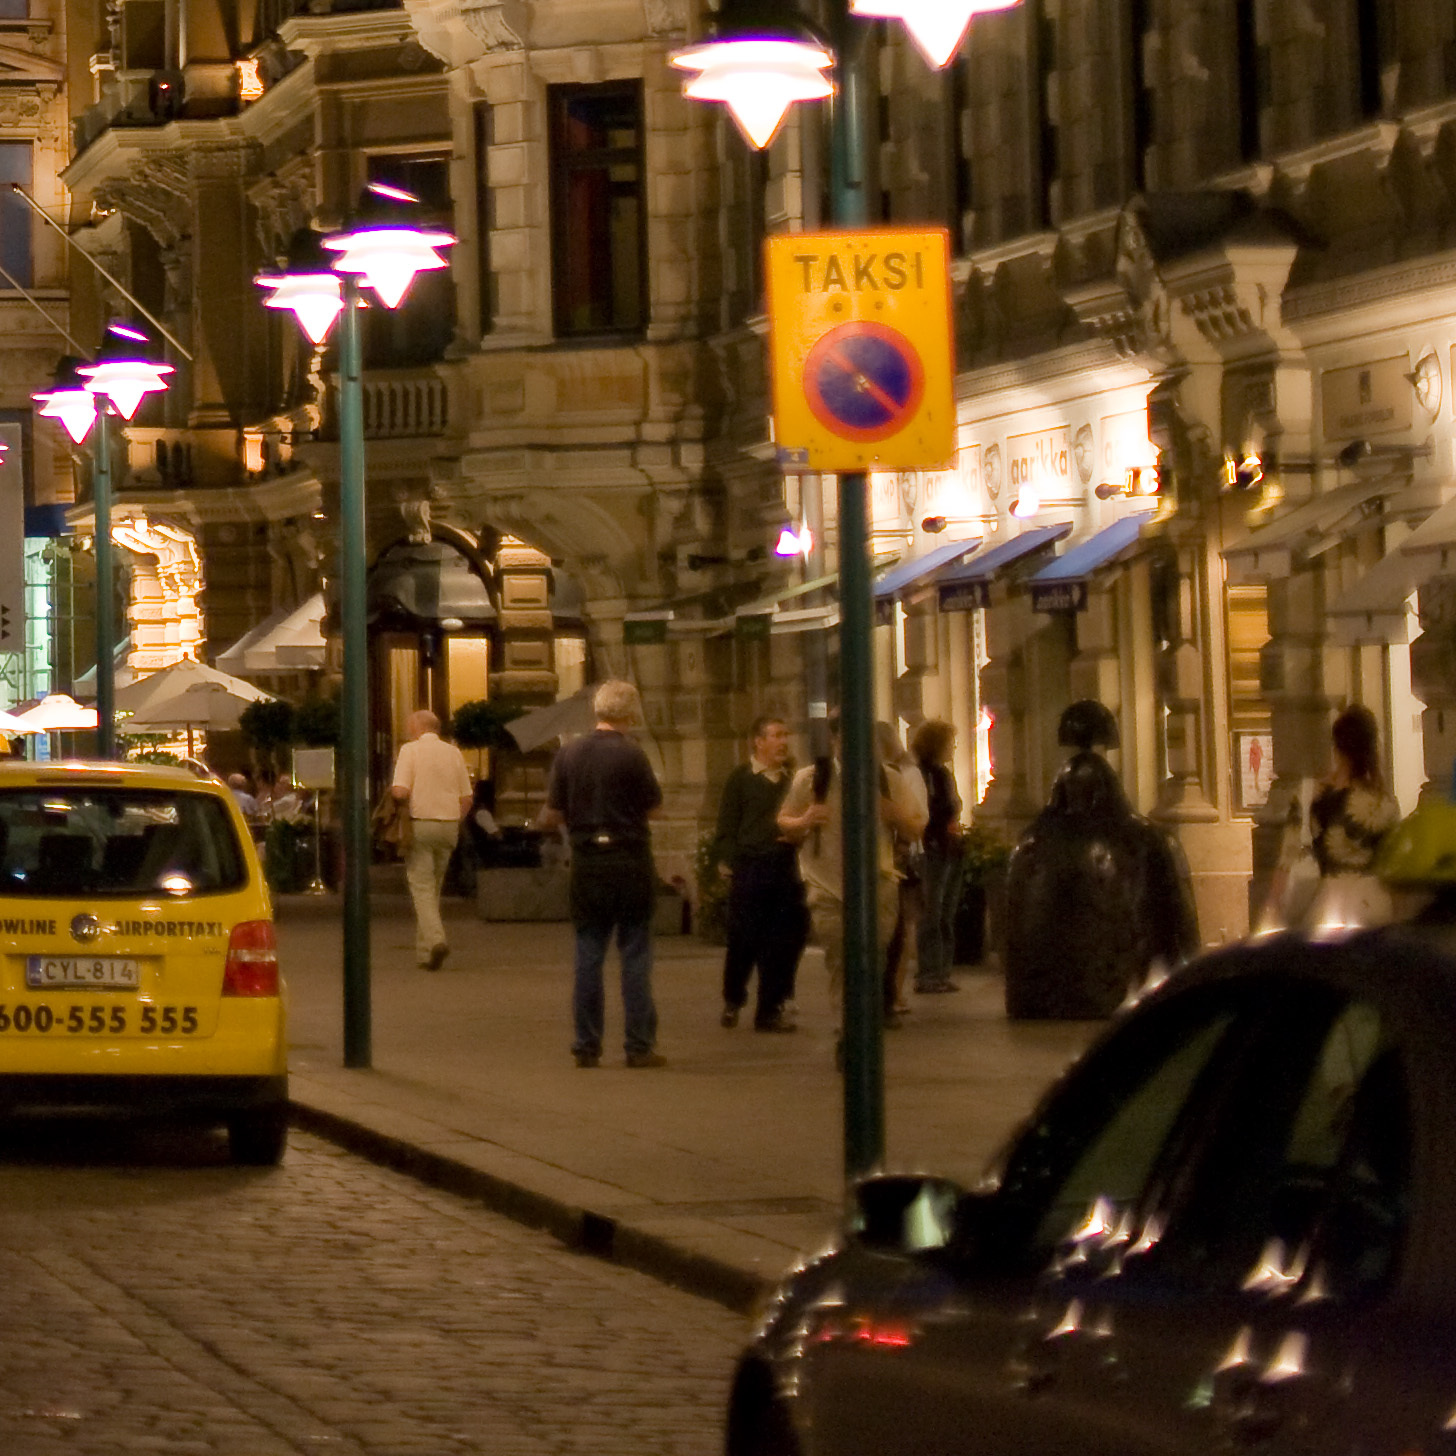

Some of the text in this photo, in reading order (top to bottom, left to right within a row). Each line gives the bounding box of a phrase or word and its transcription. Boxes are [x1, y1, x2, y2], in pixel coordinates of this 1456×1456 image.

[793, 252, 924, 293] TAKSI
[45, 961, 133, 981] CYL-814
[140, 1006, 199, 1034] 555
